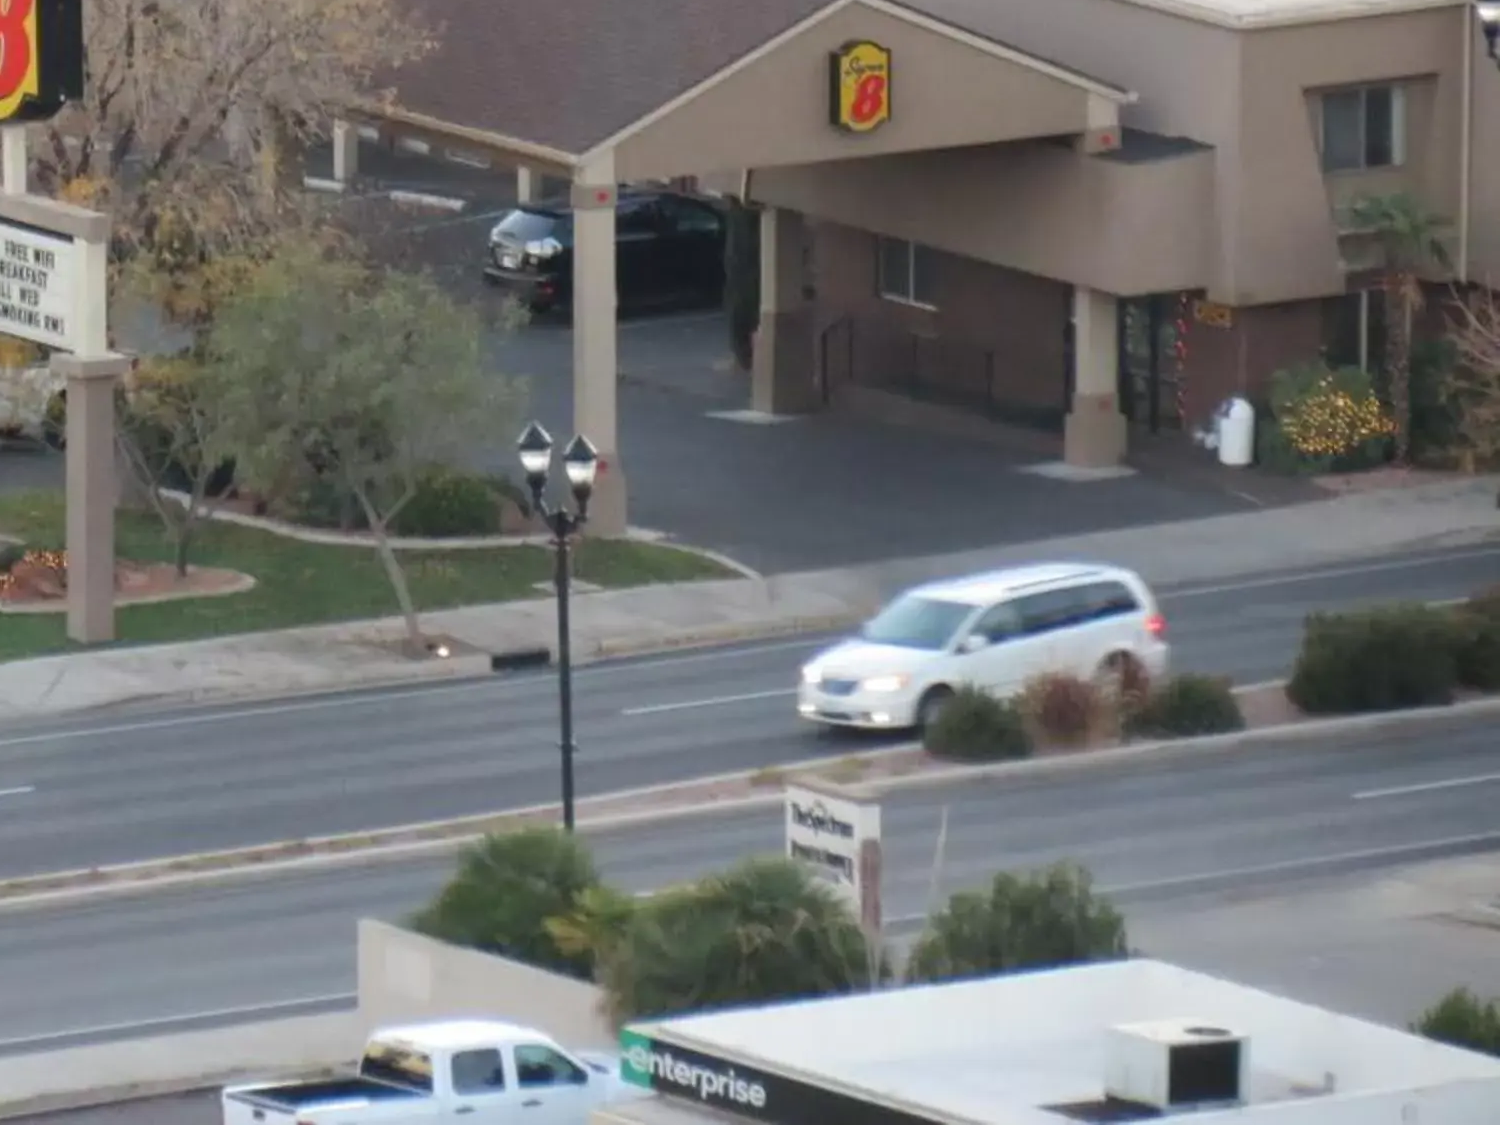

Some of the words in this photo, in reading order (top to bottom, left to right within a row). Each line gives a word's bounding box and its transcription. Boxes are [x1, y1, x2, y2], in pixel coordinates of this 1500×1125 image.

[851, 74, 886, 124] 8
[5, 239, 30, 263] FREE
[627, 1044, 767, 1109] enterprise
